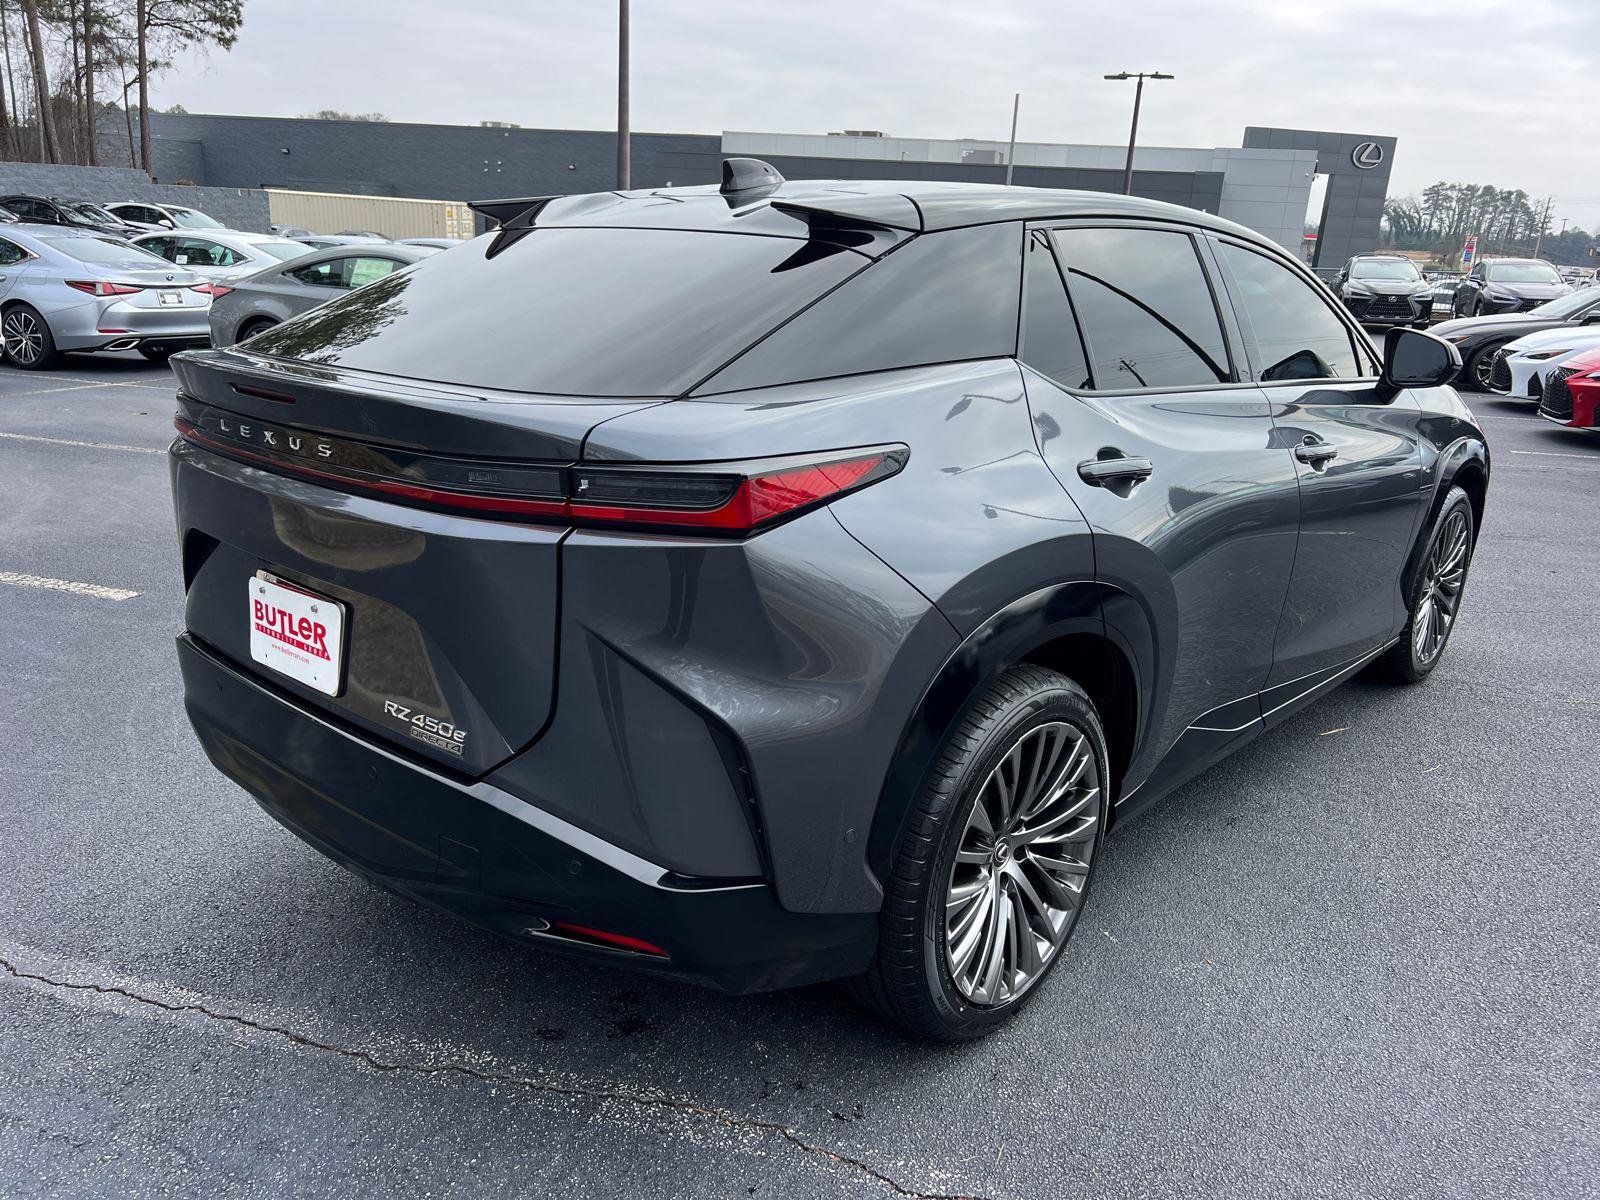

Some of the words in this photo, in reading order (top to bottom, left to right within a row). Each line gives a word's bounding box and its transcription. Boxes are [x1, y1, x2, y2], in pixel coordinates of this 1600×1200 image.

[220, 419, 333, 458] LEXUS
[384, 700, 411, 722] RZ
[411, 714, 467, 742] 450e
[411, 728, 463, 755] DIRECT4
